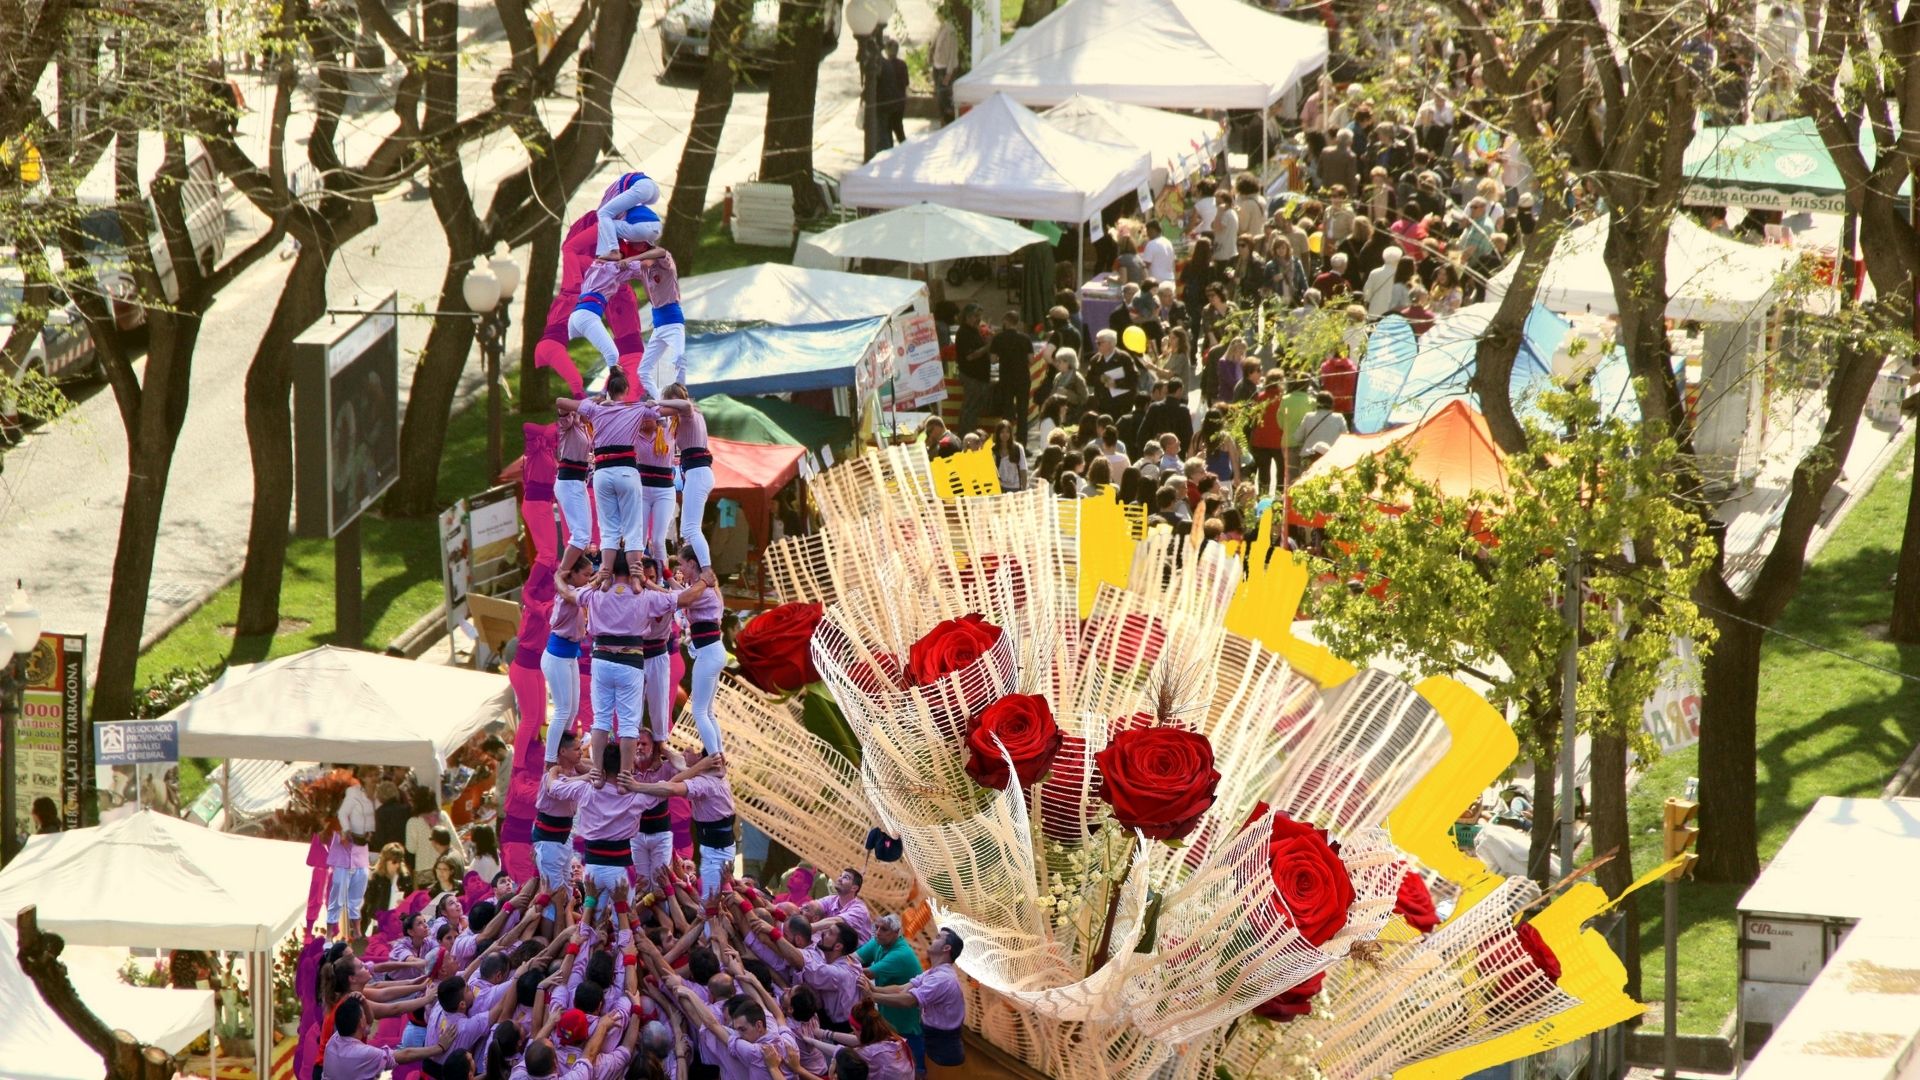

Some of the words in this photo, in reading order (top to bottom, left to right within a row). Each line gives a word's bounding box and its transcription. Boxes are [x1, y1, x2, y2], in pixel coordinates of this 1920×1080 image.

[1790, 197, 1845, 211] MISSIO
[67, 662, 78, 734] TARRAGONA
[126, 733, 173, 742] PROVINCIAL
[67, 736, 78, 754] DE
[126, 751, 166, 760] CEREBRAL
[1750, 923, 1771, 934] CIR
